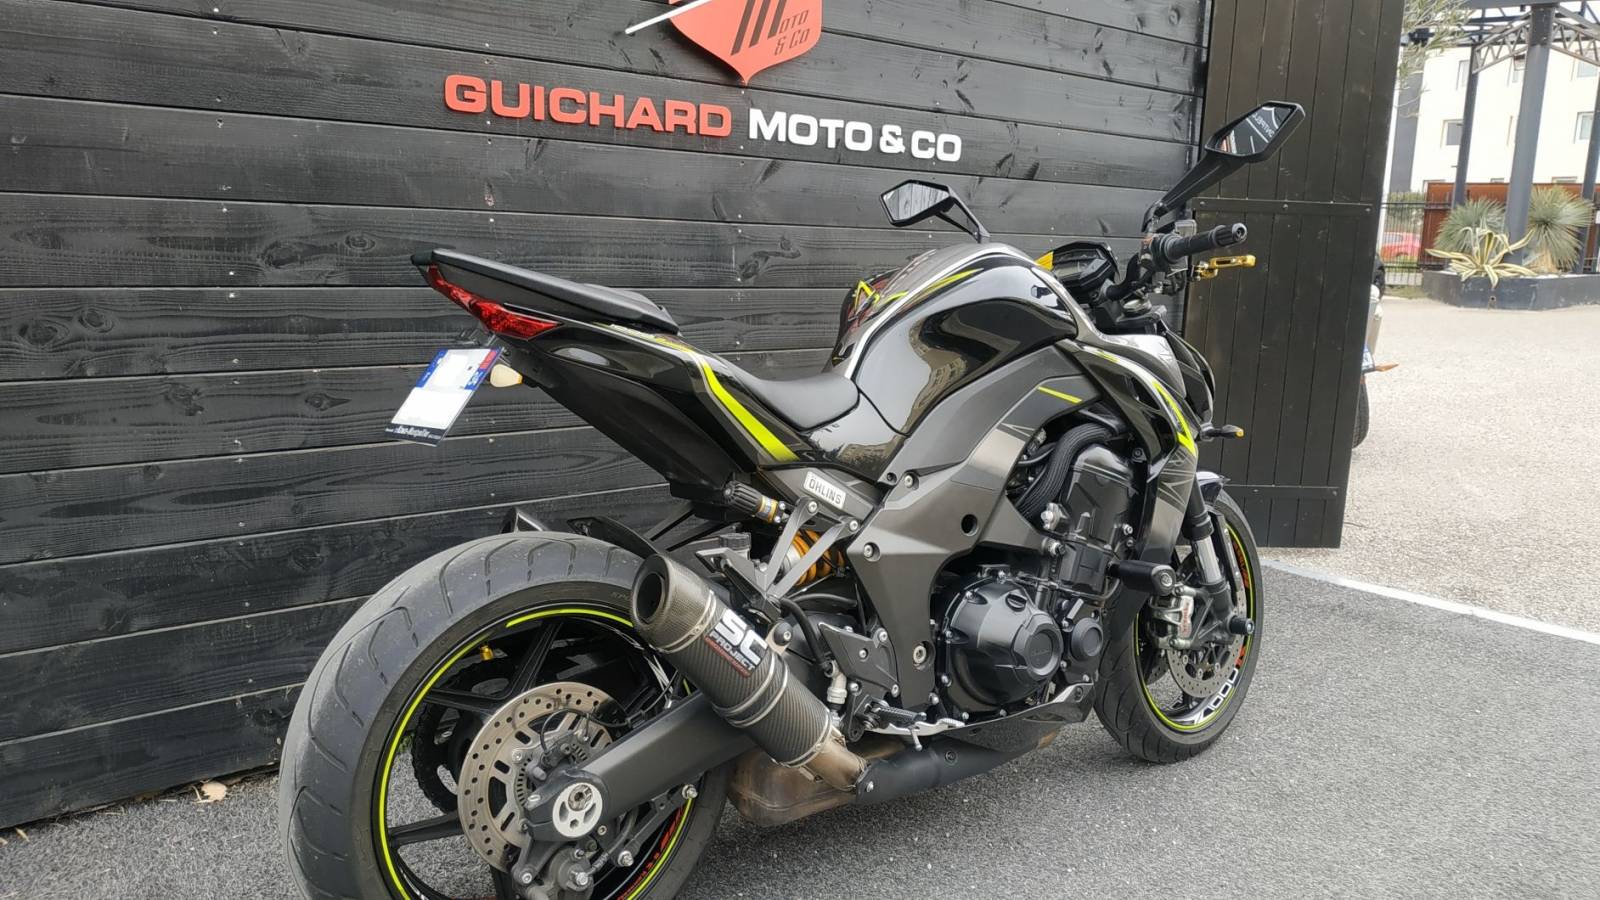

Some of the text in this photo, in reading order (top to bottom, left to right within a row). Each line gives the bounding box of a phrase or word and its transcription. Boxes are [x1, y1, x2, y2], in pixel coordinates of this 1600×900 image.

[444, 74, 732, 137] GUICHARD
[749, 108, 873, 151] MOTO
[709, 630, 756, 671] PROJECT
